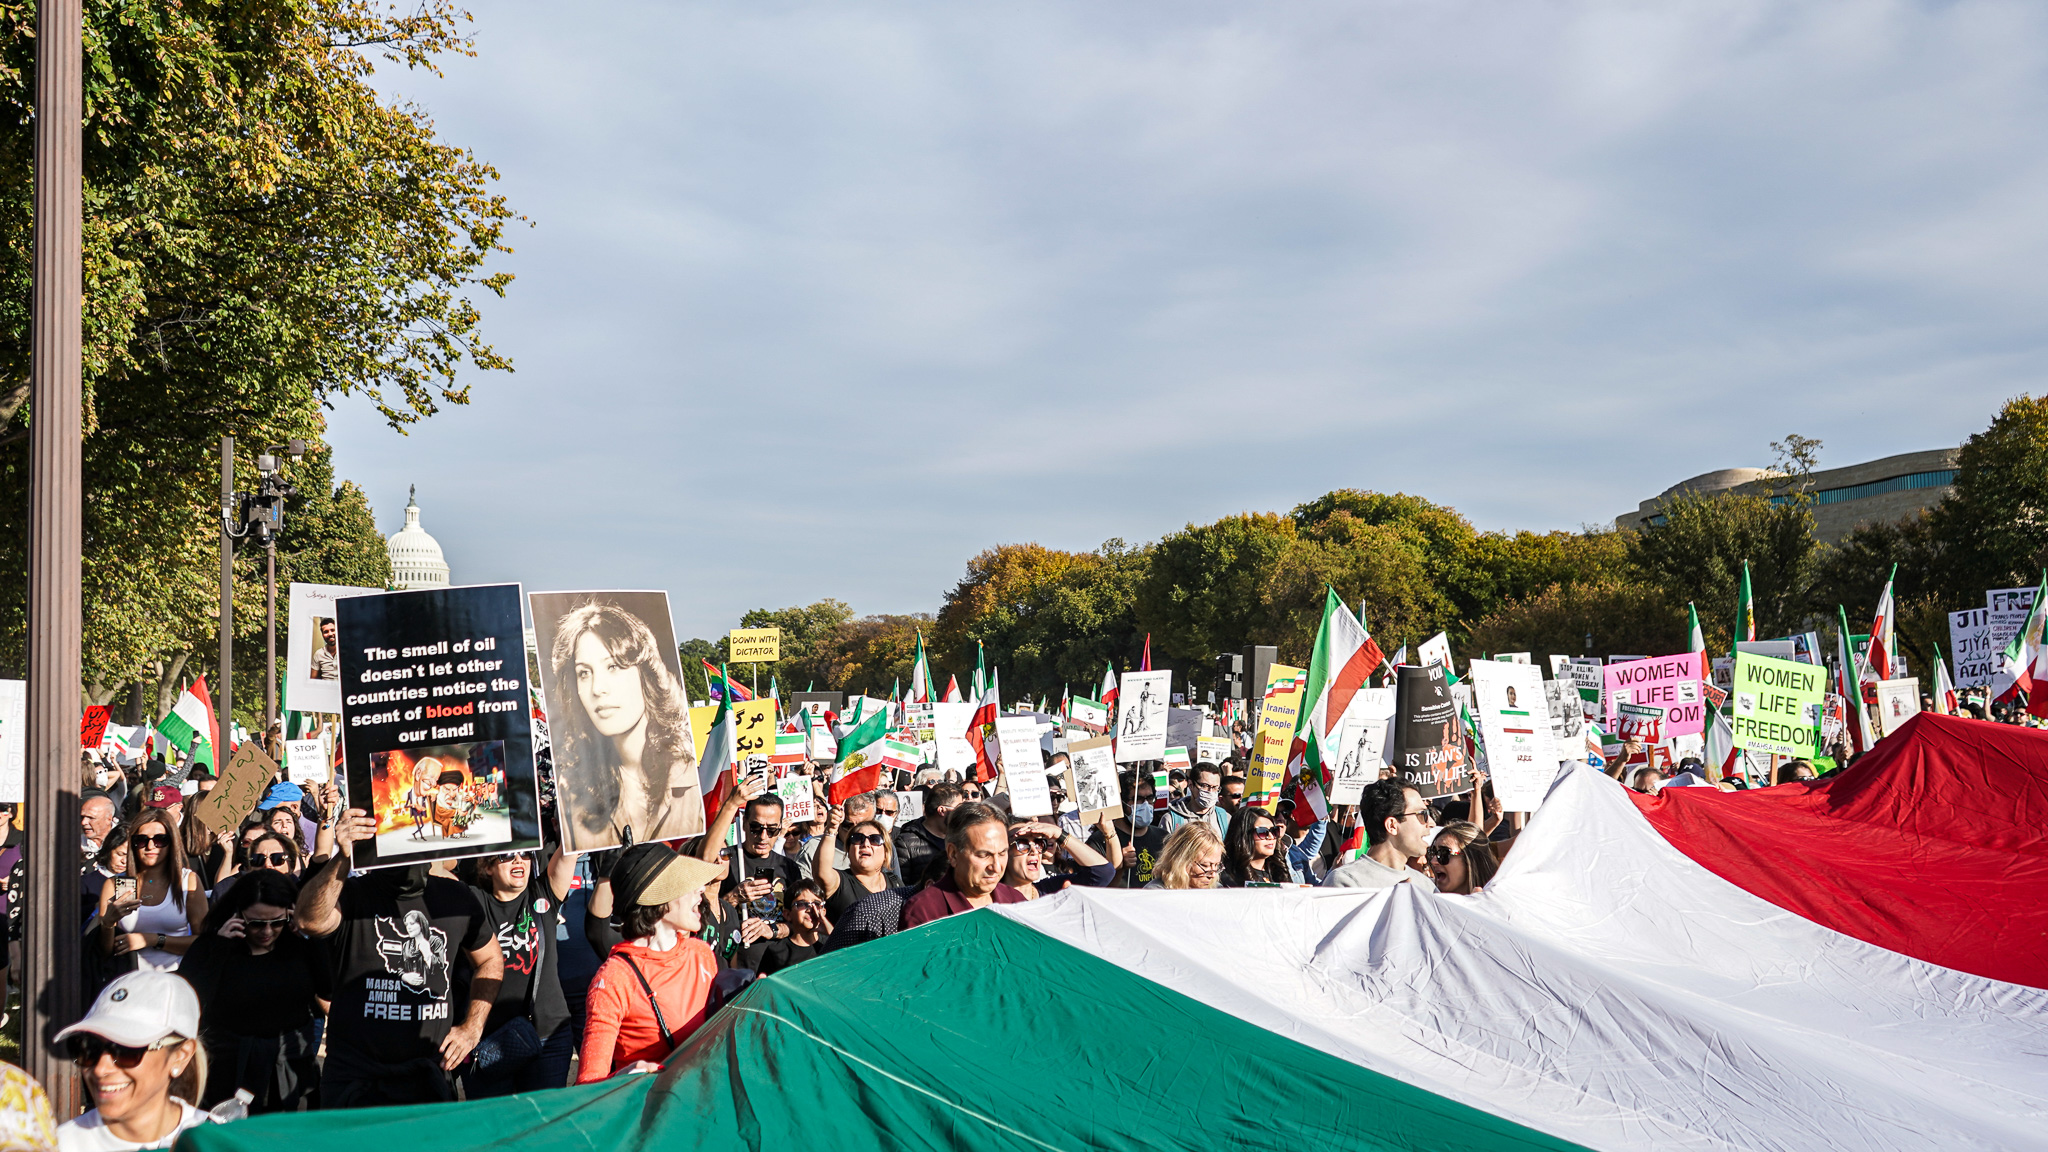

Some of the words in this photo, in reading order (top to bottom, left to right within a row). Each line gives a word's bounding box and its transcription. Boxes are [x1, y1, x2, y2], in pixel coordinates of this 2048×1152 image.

[364, 648, 397, 661] The
[401, 641, 448, 657] smell
[452, 639, 470, 653] of
[474, 637, 496, 651] oil
[736, 647, 774, 656] DICTATOR
[429, 662, 453, 676] let
[457, 660, 503, 674] other
[1616, 661, 1689, 685] WOMEN
[1748, 663, 1814, 692] WOMEN
[346, 687, 428, 706] countries
[432, 681, 487, 697] notice
[491, 678, 520, 691] the
[1636, 686, 1674, 705] LIFE
[1266, 703, 1295, 715] Iranian
[1759, 692, 1797, 715] LIFE
[351, 709, 401, 726] scent
[404, 706, 423, 720] of
[426, 702, 474, 719] blood
[478, 700, 517, 714] from
[1264, 717, 1291, 729] People
[398, 728, 428, 742] our
[432, 723, 474, 739] land!
[1263, 736, 1284, 746] Want
[1736, 717, 1820, 748] FREEDOM
[1748, 741, 1773, 750] #MAHSA
[1776, 744, 1794, 753] AMINI
[1254, 753, 1284, 765] Regime
[1405, 754, 1420, 767] IS
[1425, 747, 1463, 766] IRAN'S
[1251, 768, 1280, 780] Change
[1405, 770, 1440, 785] DAILY
[1444, 764, 1468, 781] LIFE
[785, 801, 811, 811] FREE
[786, 809, 809, 818] DOM
[366, 978, 401, 991] MAHSA
[368, 991, 397, 1003] AMINI
[364, 1002, 412, 1020] FREE
